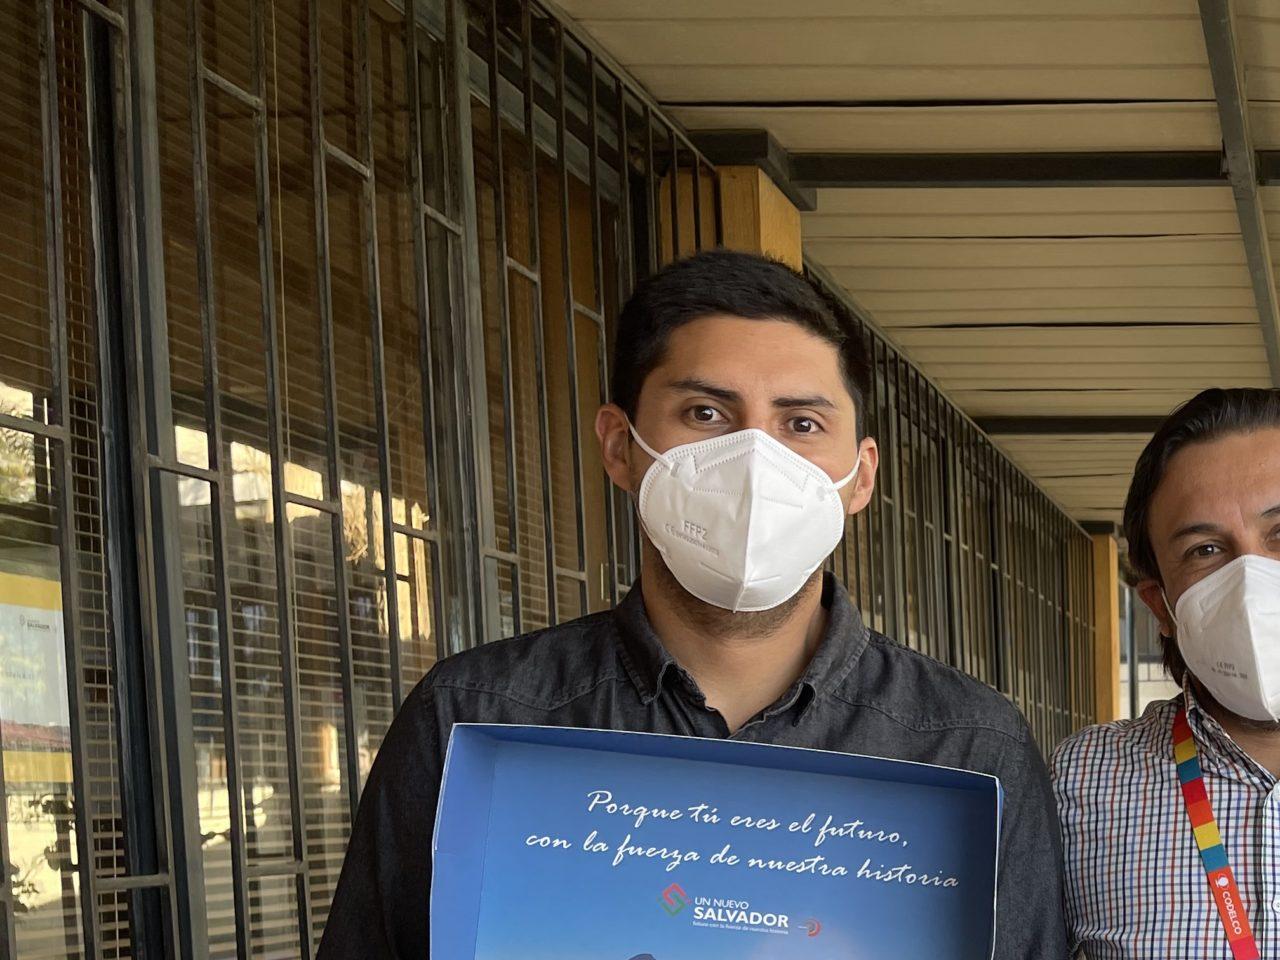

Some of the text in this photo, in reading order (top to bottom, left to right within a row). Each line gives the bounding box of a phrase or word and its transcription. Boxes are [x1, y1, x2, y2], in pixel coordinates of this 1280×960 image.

[587, 790, 908, 846] Porque tú eres el futuro,
[525, 831, 958, 888] con la fuerza de nuestra historia
[693, 907, 788, 928] SALVADOR
[695, 897, 749, 910] UN NUEVO
[1223, 891, 1242, 935] CODELCO
